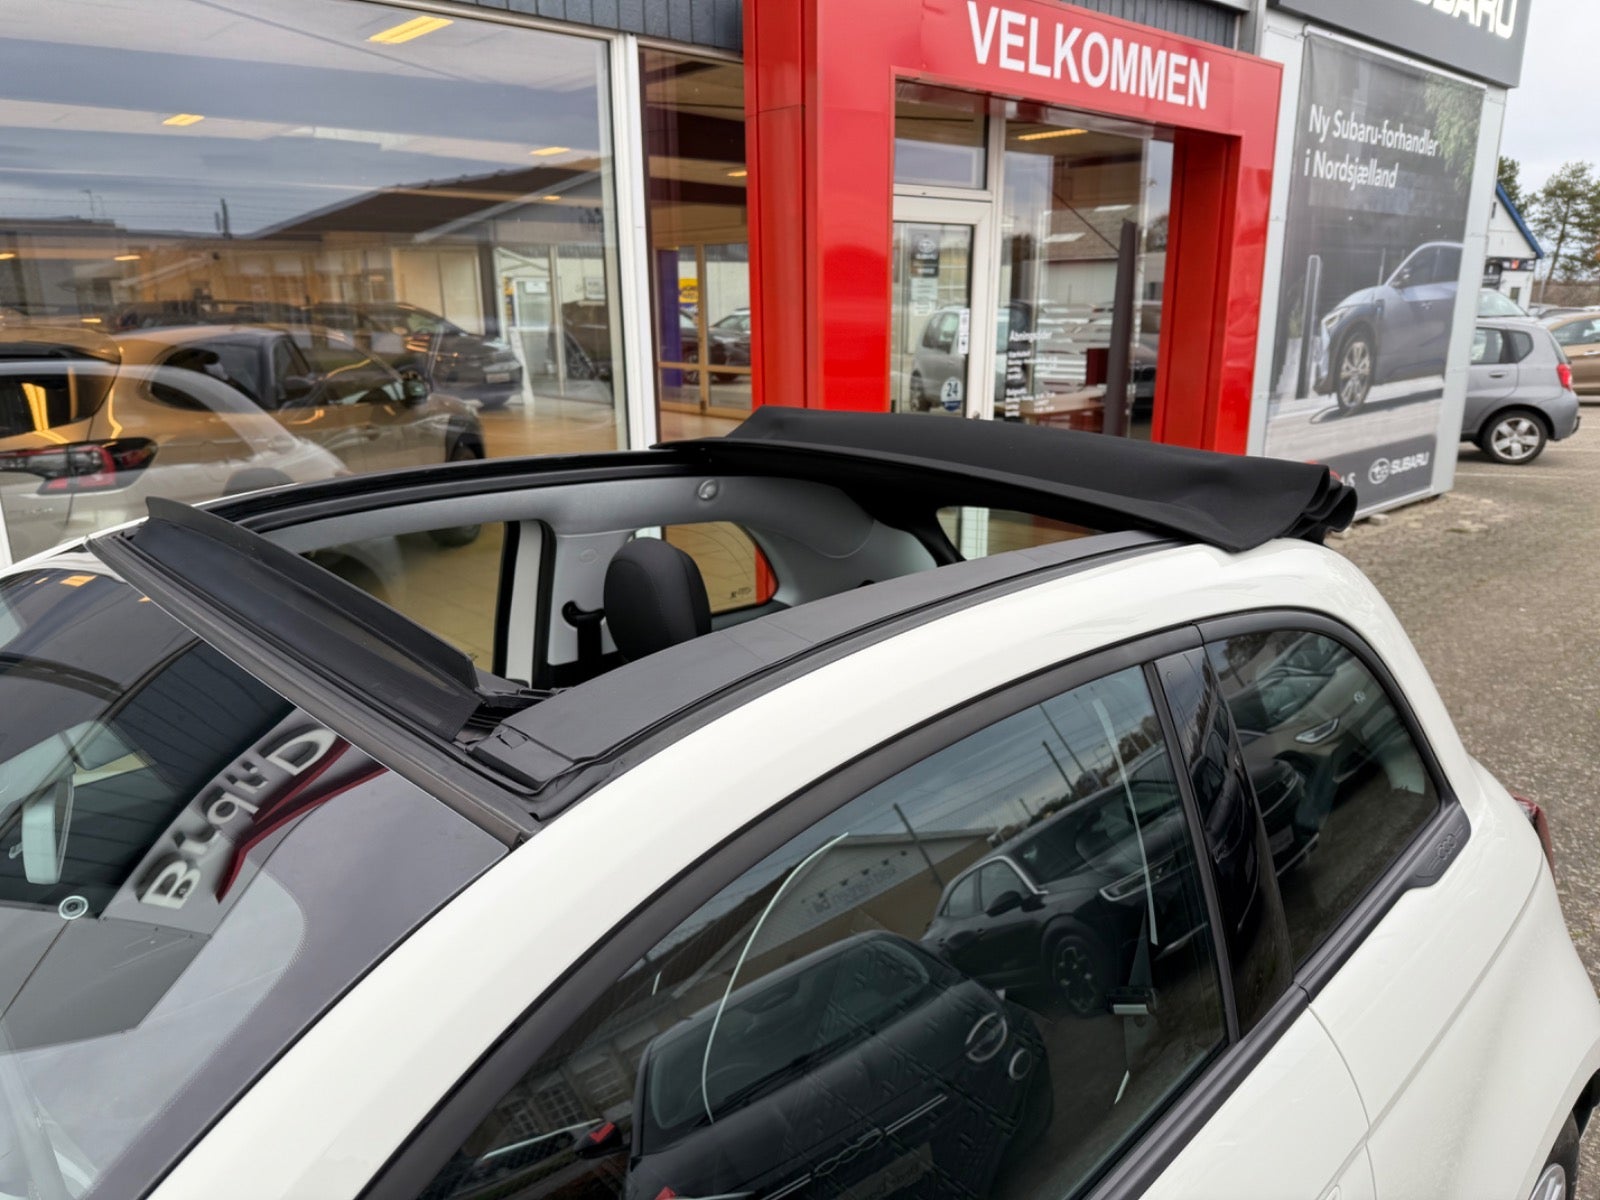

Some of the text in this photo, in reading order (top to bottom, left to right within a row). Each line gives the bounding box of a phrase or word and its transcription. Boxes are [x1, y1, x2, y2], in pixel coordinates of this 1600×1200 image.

[967, 1, 1209, 110] VELKOMMEN
[1309, 103, 1439, 156] Ny Subaru-forhandler
[1304, 148, 1399, 191] i Nordsjælland
[946, 382, 959, 397] 24
[1389, 451, 1430, 475] SUBARU
